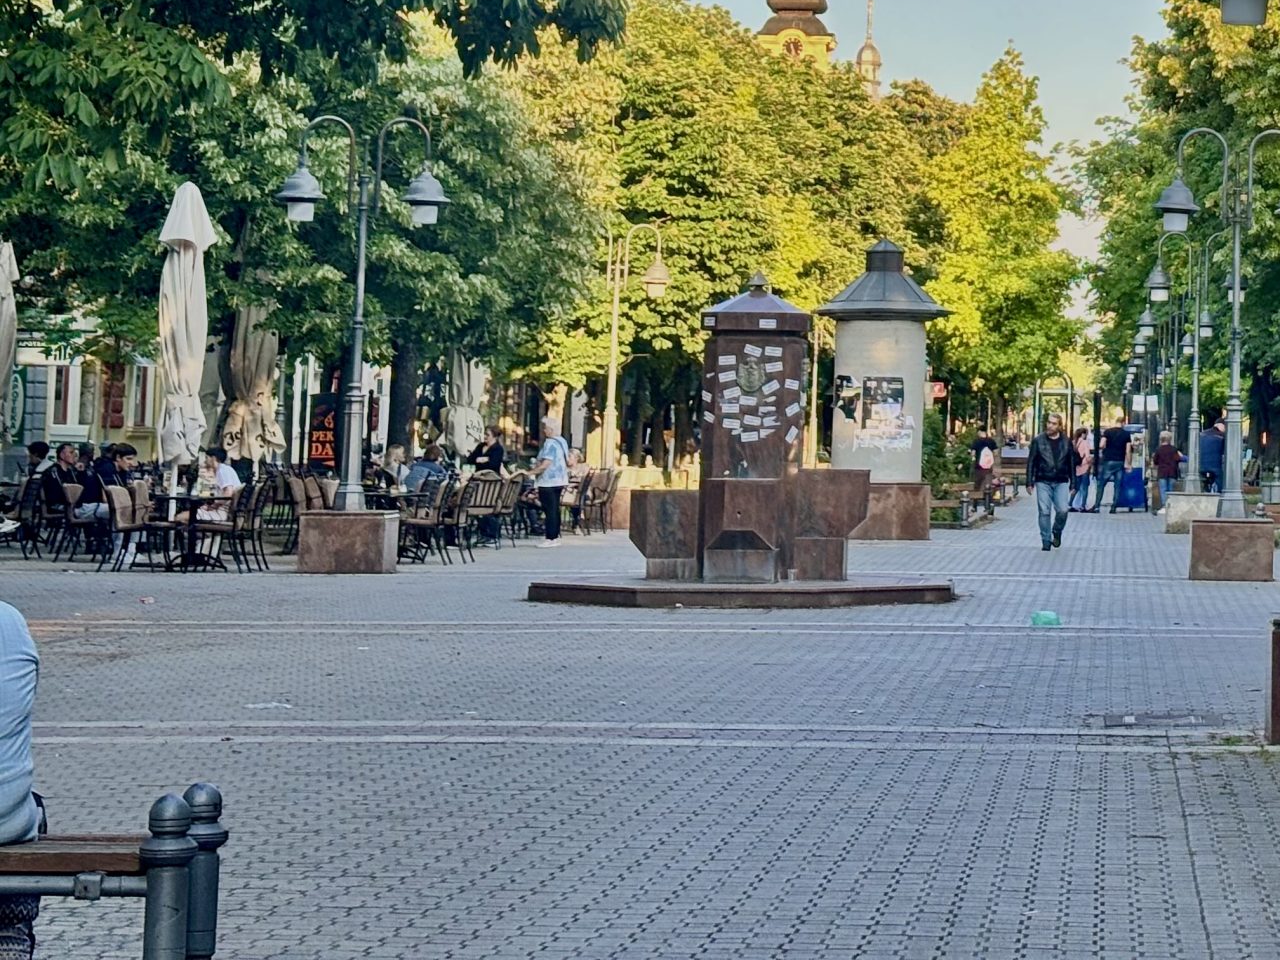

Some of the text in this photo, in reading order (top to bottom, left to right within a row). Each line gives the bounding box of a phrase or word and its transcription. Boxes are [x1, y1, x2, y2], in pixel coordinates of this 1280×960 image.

[11, 376, 19, 429] APOTEKA
[311, 430, 334, 441] PEK
[311, 442, 334, 455] DA
